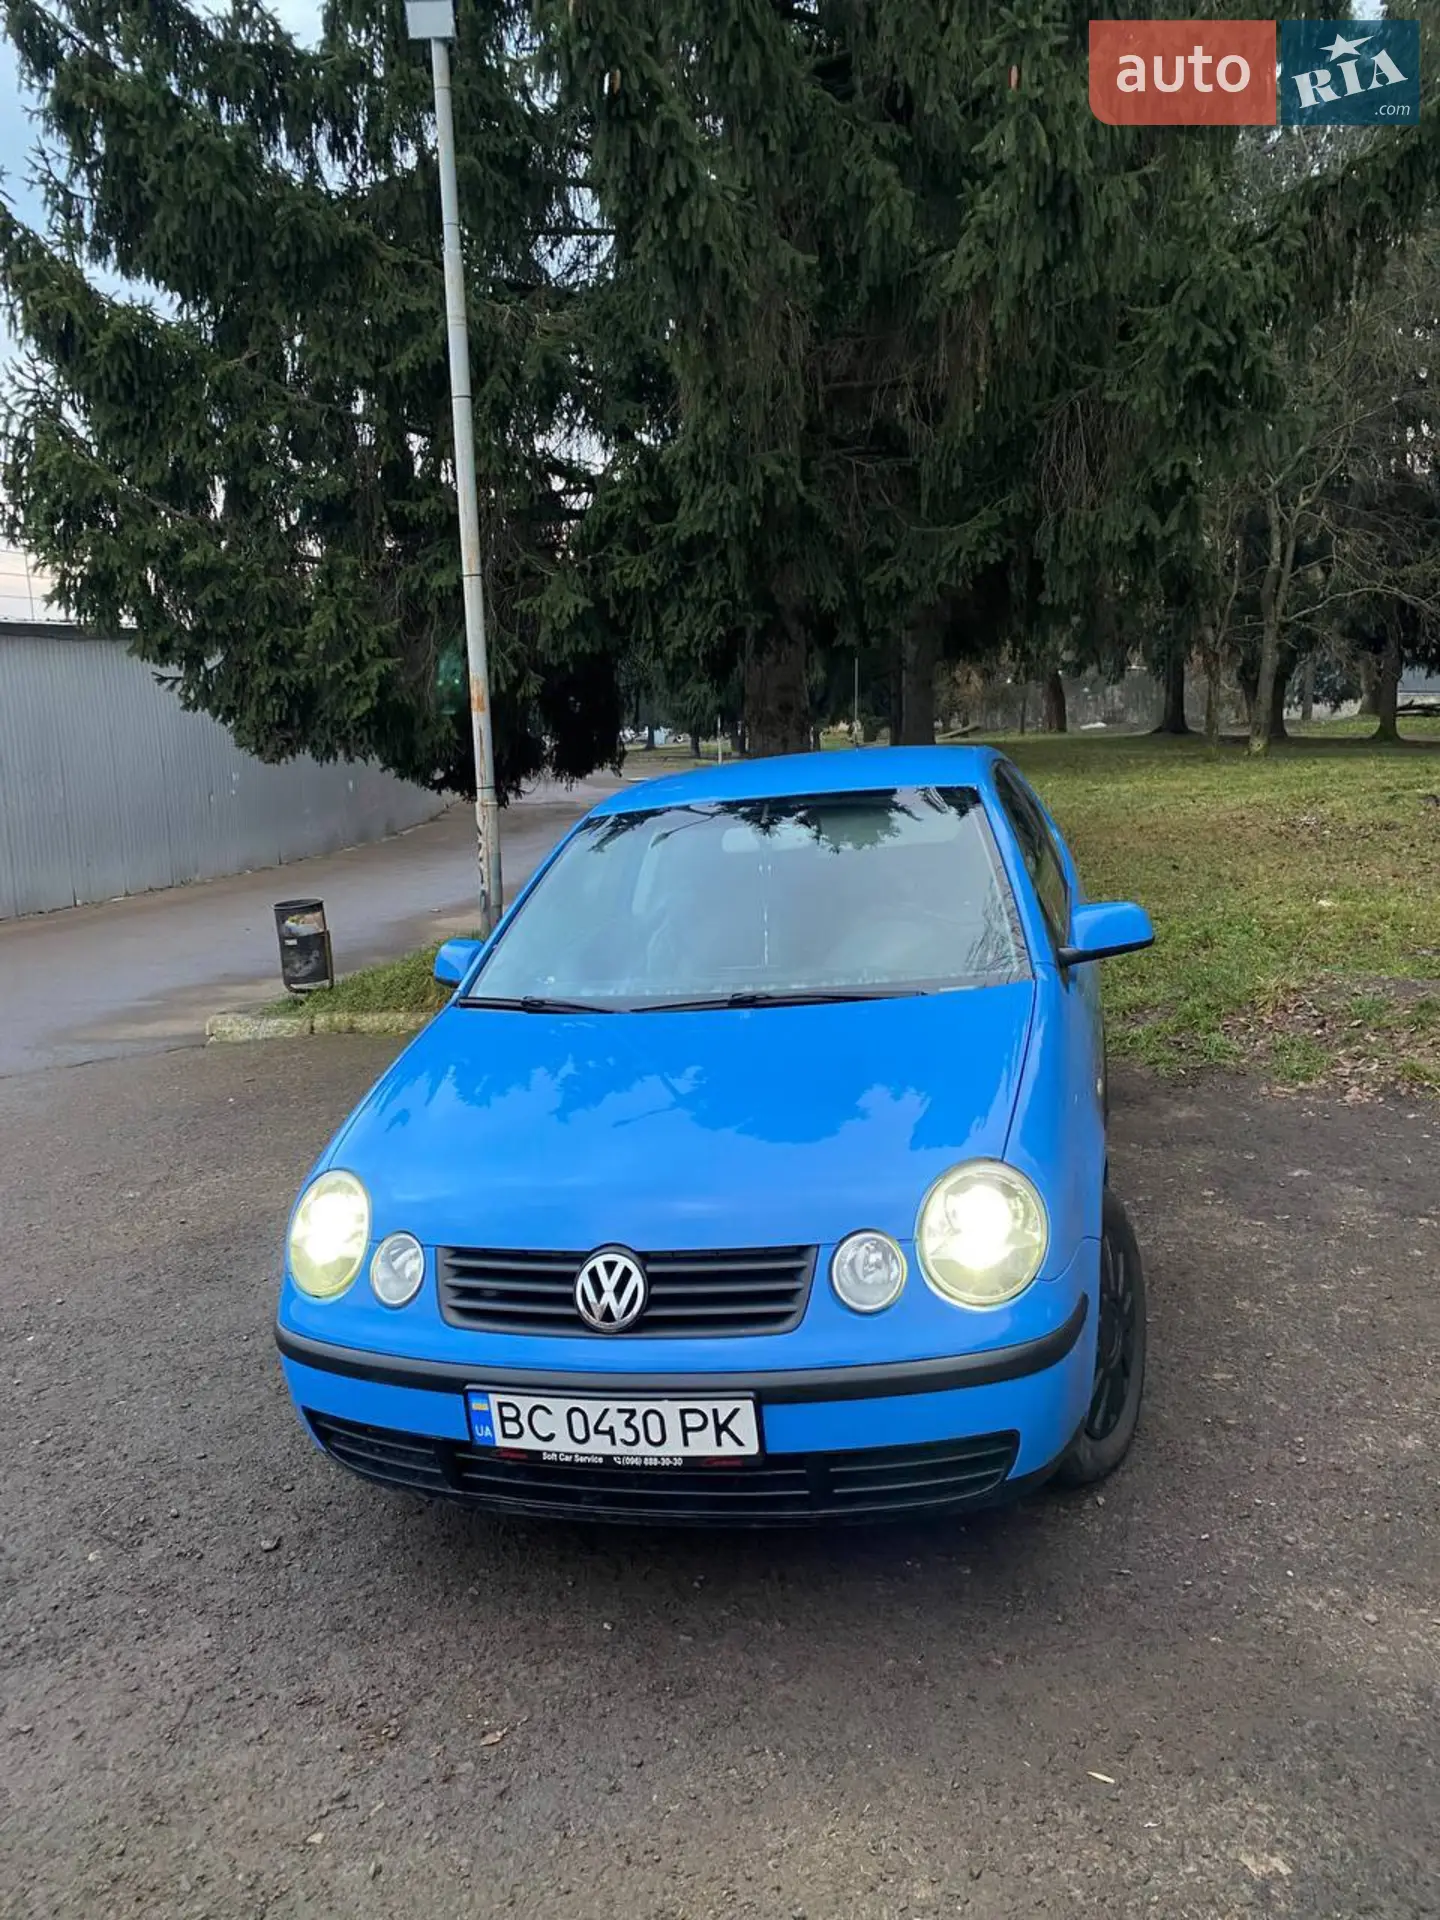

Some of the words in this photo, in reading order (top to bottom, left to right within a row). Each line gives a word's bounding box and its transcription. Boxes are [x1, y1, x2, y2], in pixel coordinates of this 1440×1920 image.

[497, 1401, 556, 1442] BC
[566, 1406, 667, 1447] 0430
[679, 1408, 745, 1447] PK
[475, 1425, 493, 1438] UA
[559, 1453, 572, 1462] Car
[574, 1454, 604, 1464] Service
